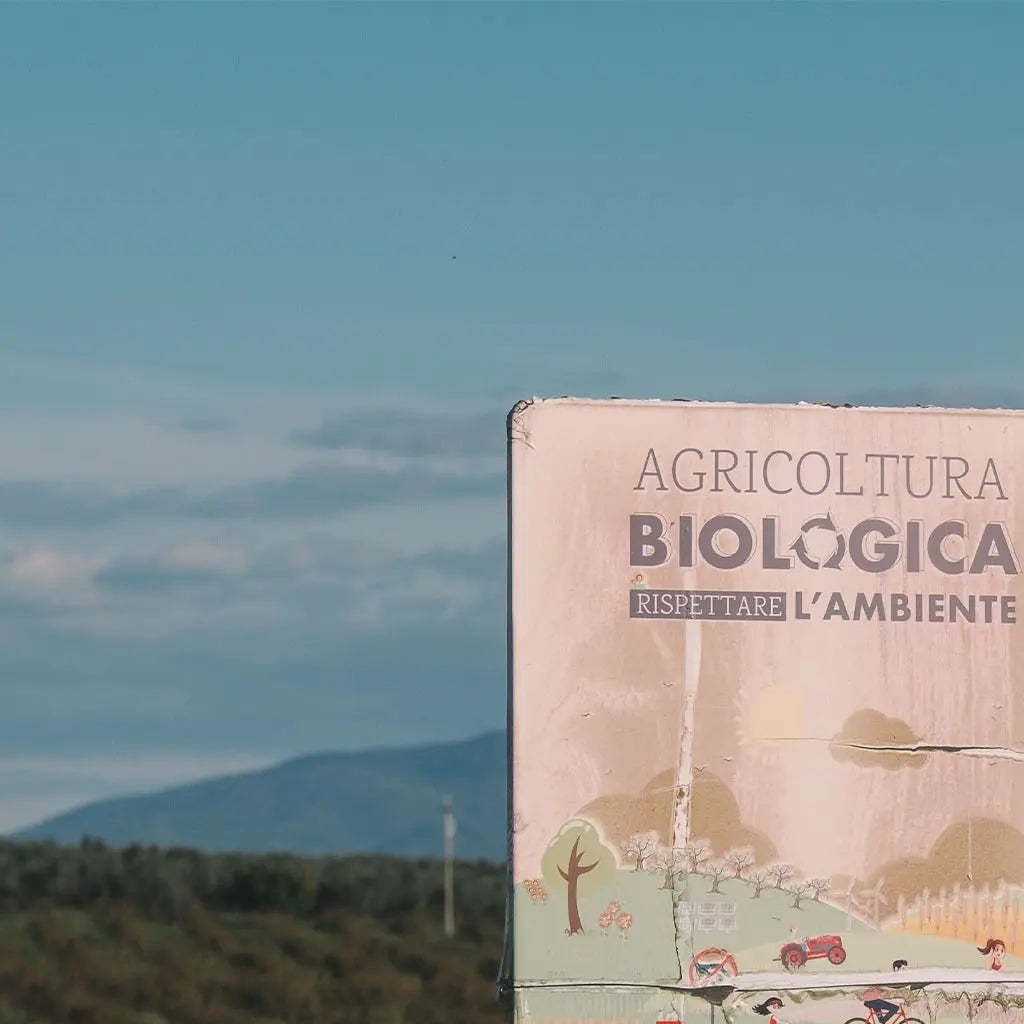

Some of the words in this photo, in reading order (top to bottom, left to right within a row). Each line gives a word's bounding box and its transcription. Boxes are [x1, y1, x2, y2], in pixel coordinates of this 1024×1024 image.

[632, 447, 1009, 501] AGRICOLTURA
[636, 592, 783, 618] RISPETTARE
[795, 591, 1017, 624] L'AMBIENTE
